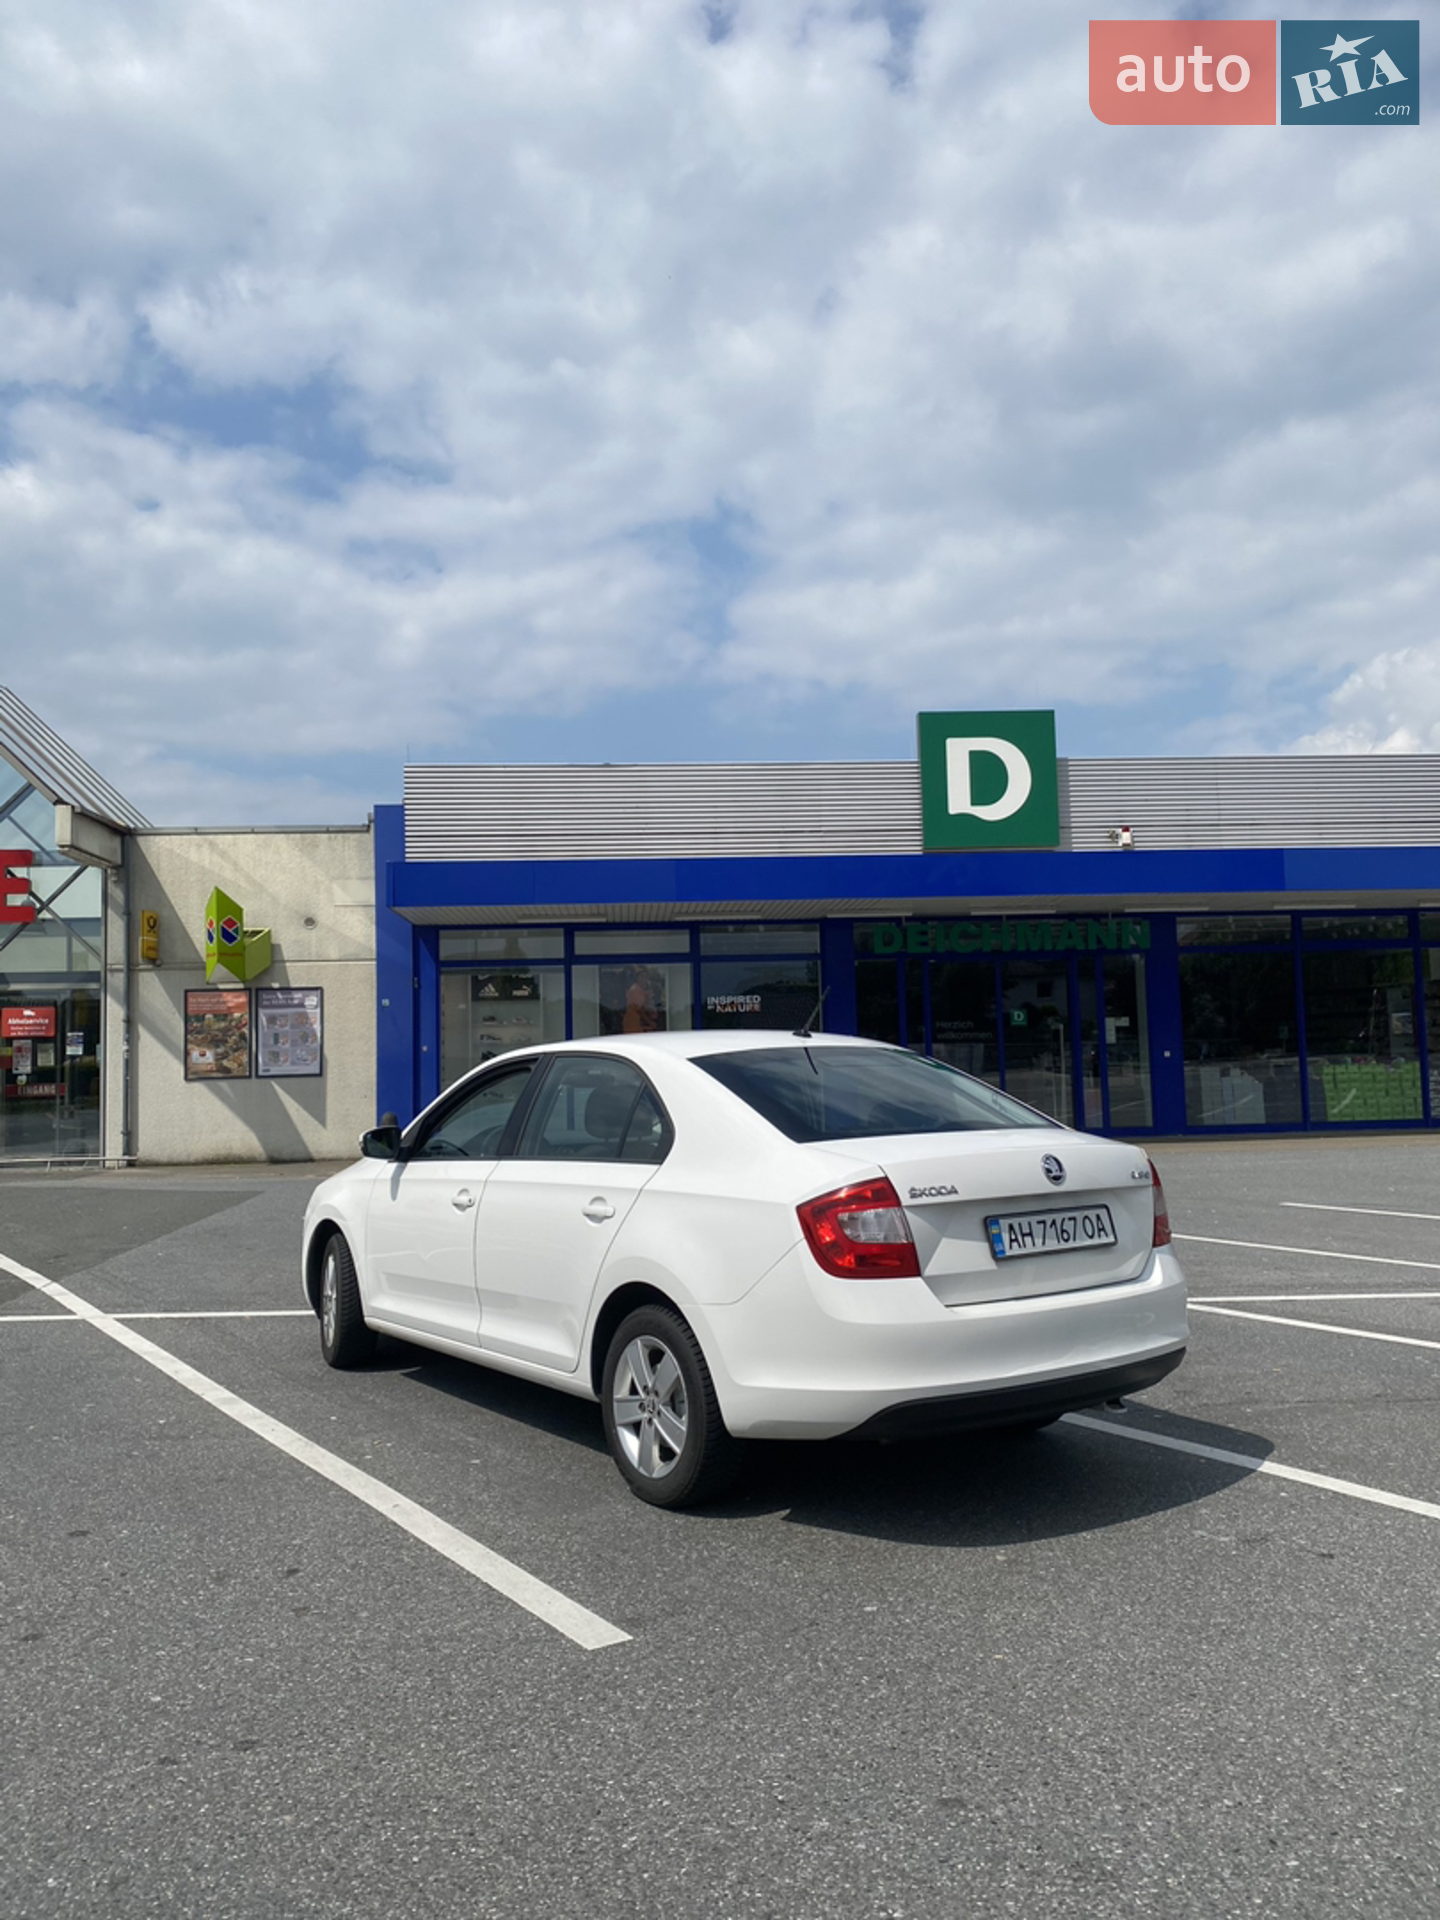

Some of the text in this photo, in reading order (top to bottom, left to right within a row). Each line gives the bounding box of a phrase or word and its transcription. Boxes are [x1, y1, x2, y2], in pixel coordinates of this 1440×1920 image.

[946, 737, 1032, 821] D
[873, 920, 1151, 954] DEICHMANN
[707, 994, 761, 1005] INSPIRED
[935, 1020, 975, 1030] Herzlich
[936, 1031, 993, 1040] willkommen
